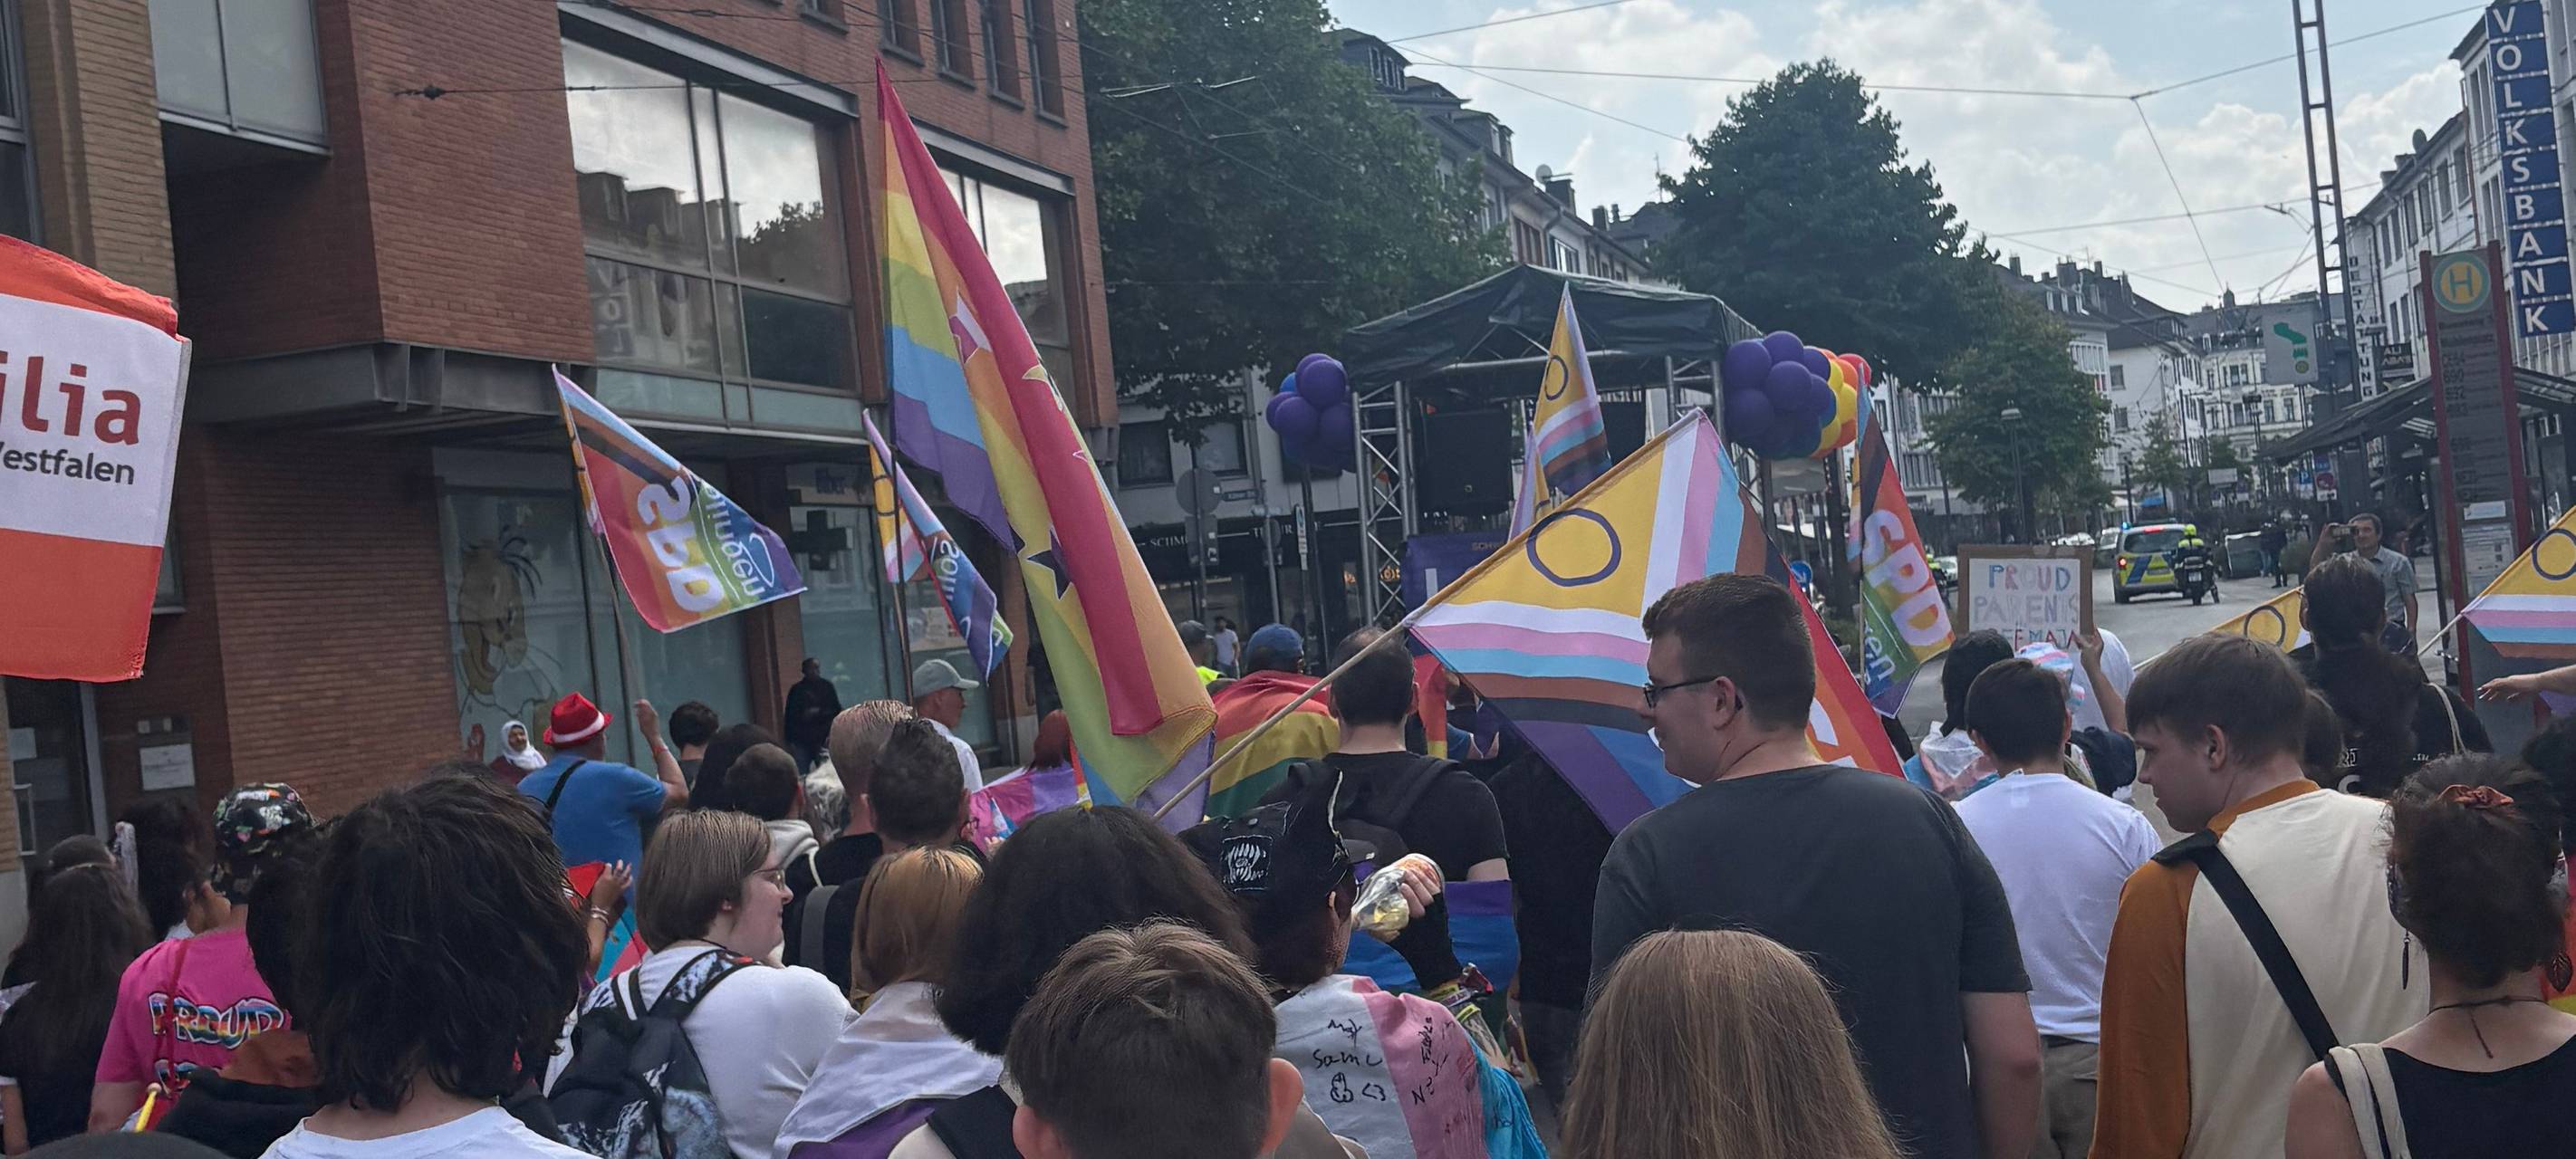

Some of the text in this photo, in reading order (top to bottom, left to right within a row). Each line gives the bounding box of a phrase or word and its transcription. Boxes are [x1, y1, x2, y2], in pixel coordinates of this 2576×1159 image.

[2492, 5, 2549, 332] VOLKSBANK
[2349, 255, 2373, 397] BESTATTUNG
[0, 441, 134, 485] estfalen
[1862, 509, 1953, 647] SPD
[1974, 593, 2080, 625] PARENTS
[1988, 564, 2071, 591] PROUD
